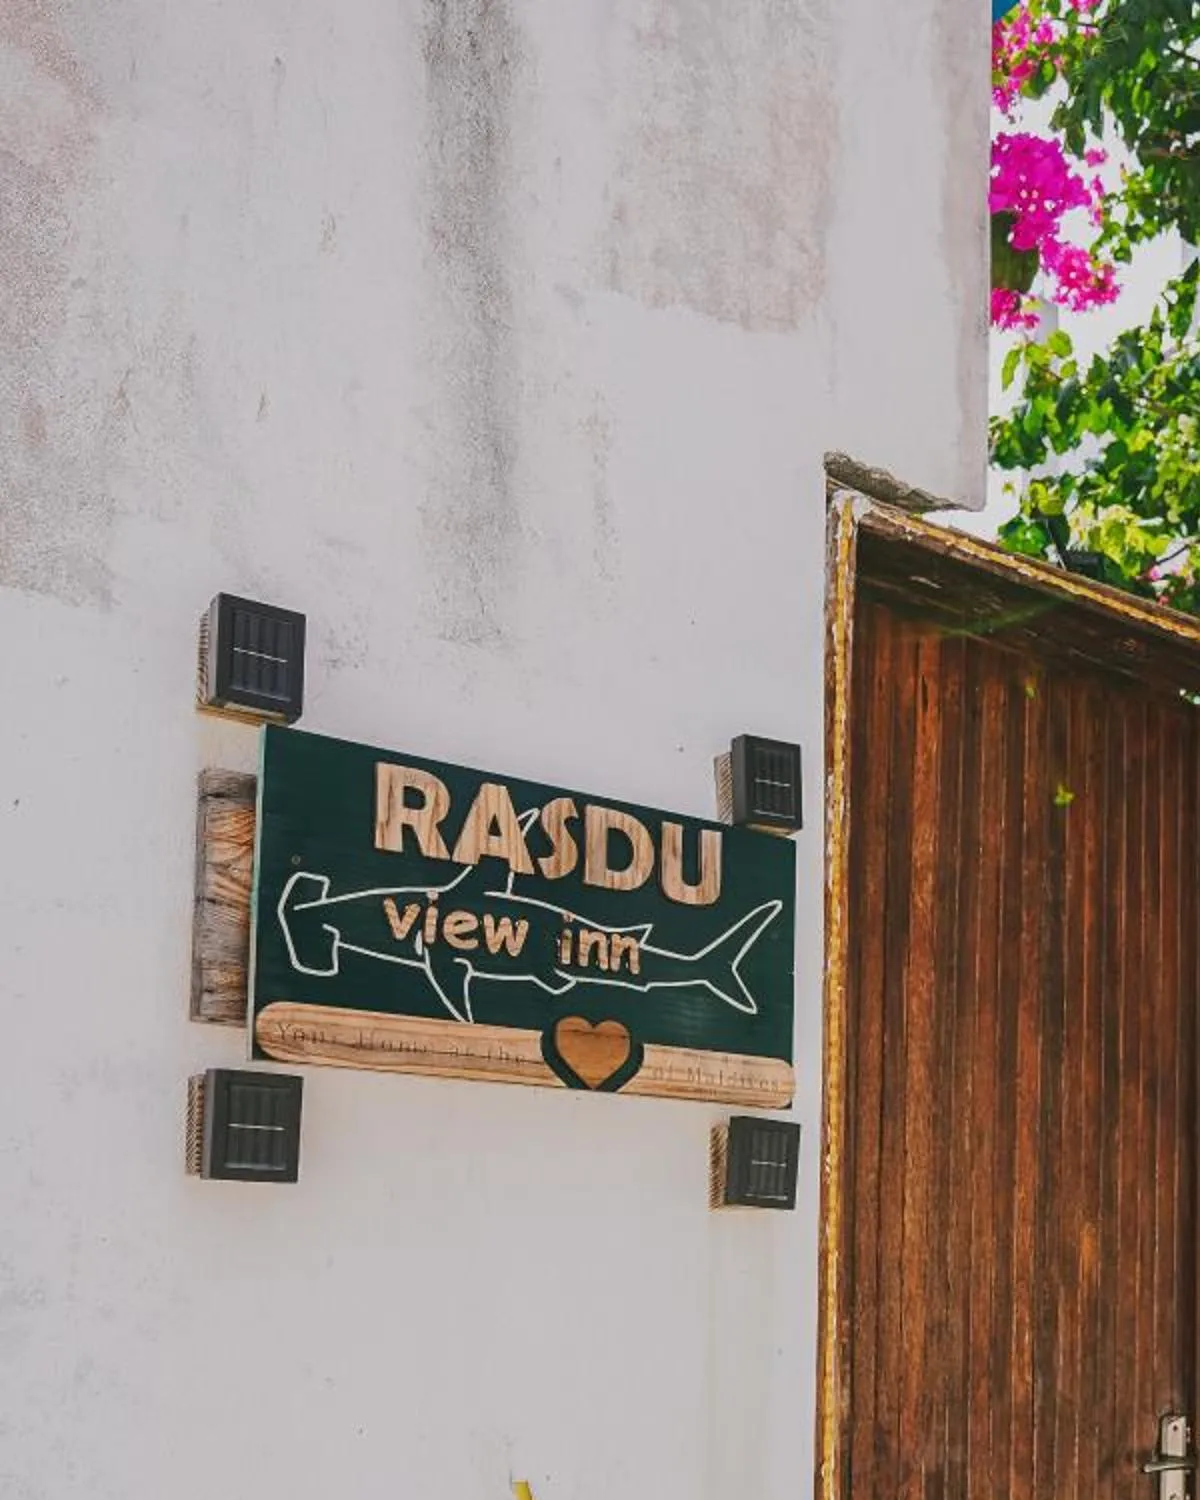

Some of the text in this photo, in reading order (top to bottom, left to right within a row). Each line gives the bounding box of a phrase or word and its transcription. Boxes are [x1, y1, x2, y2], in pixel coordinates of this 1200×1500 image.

[374, 761, 723, 905] RASDU
[383, 889, 641, 975] view inn
